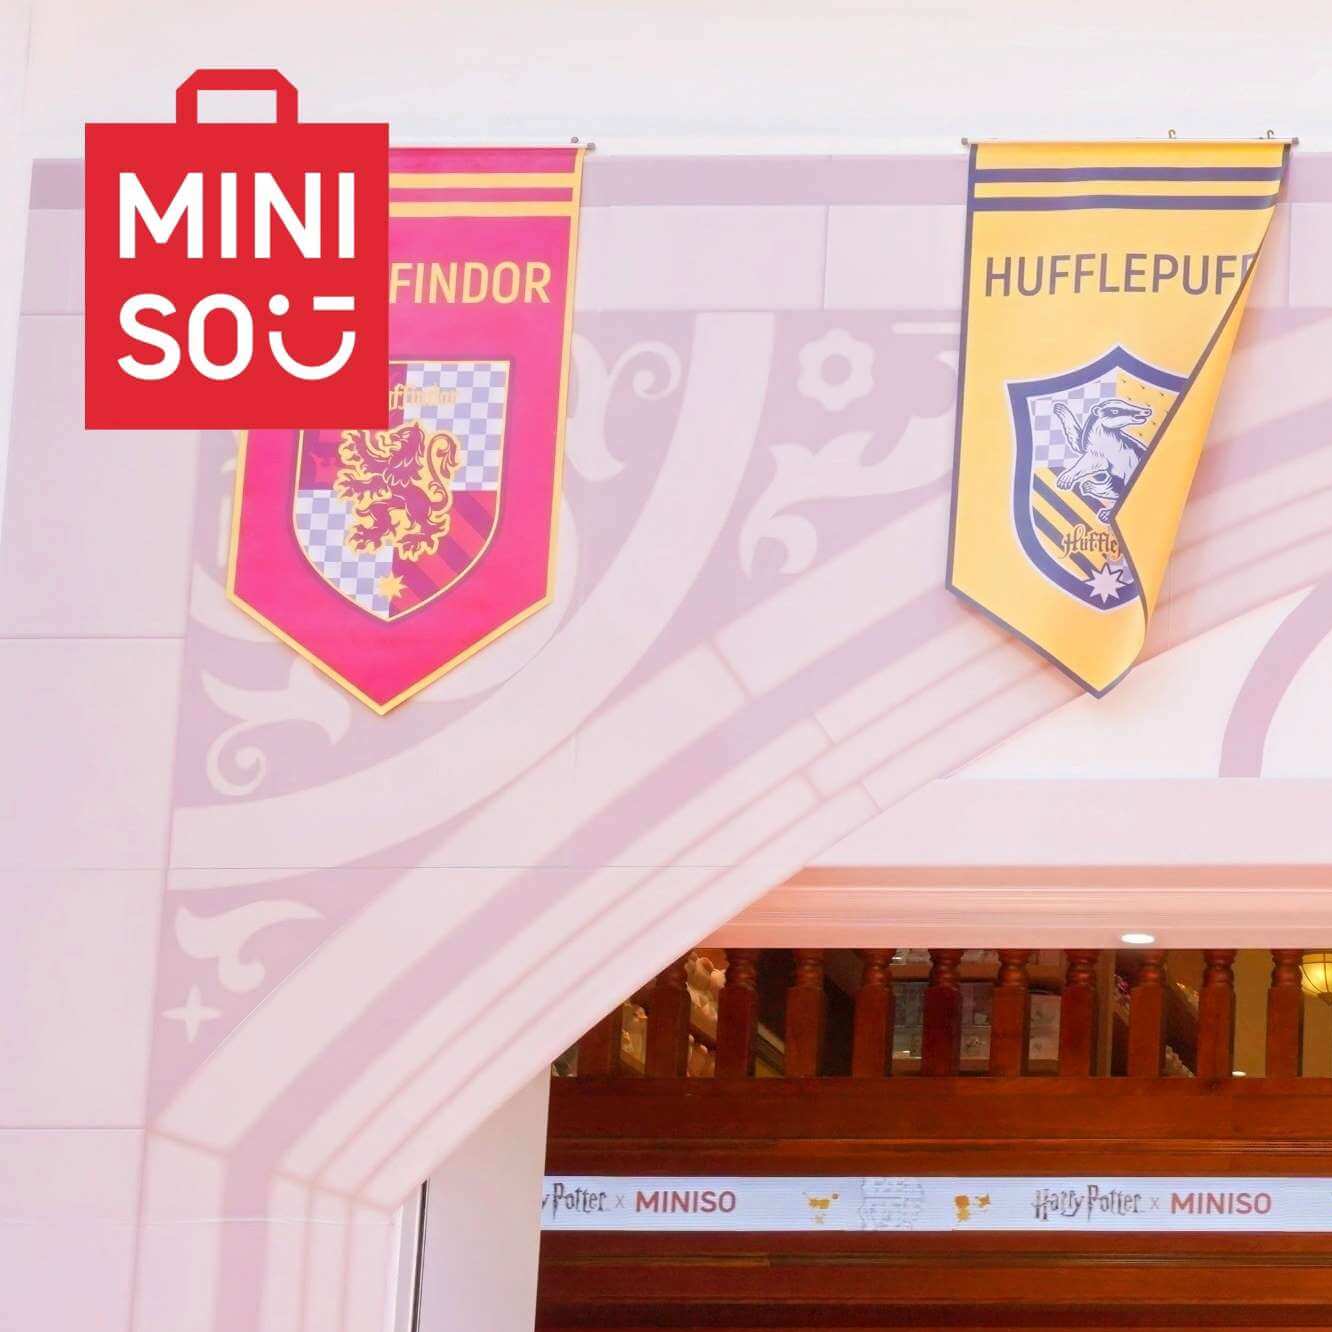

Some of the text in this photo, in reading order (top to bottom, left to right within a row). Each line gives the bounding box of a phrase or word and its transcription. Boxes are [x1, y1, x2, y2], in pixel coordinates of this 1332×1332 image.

[388, 260, 552, 305] FINDOR
[1059, 523, 1120, 560] Huffle
[551, 1182, 608, 1222] Potter
[634, 1190, 737, 1214] MINISO
[1032, 1187, 1085, 1221] Harry
[1087, 1184, 1143, 1222] Potter
[1170, 1192, 1273, 1215] MINISO
